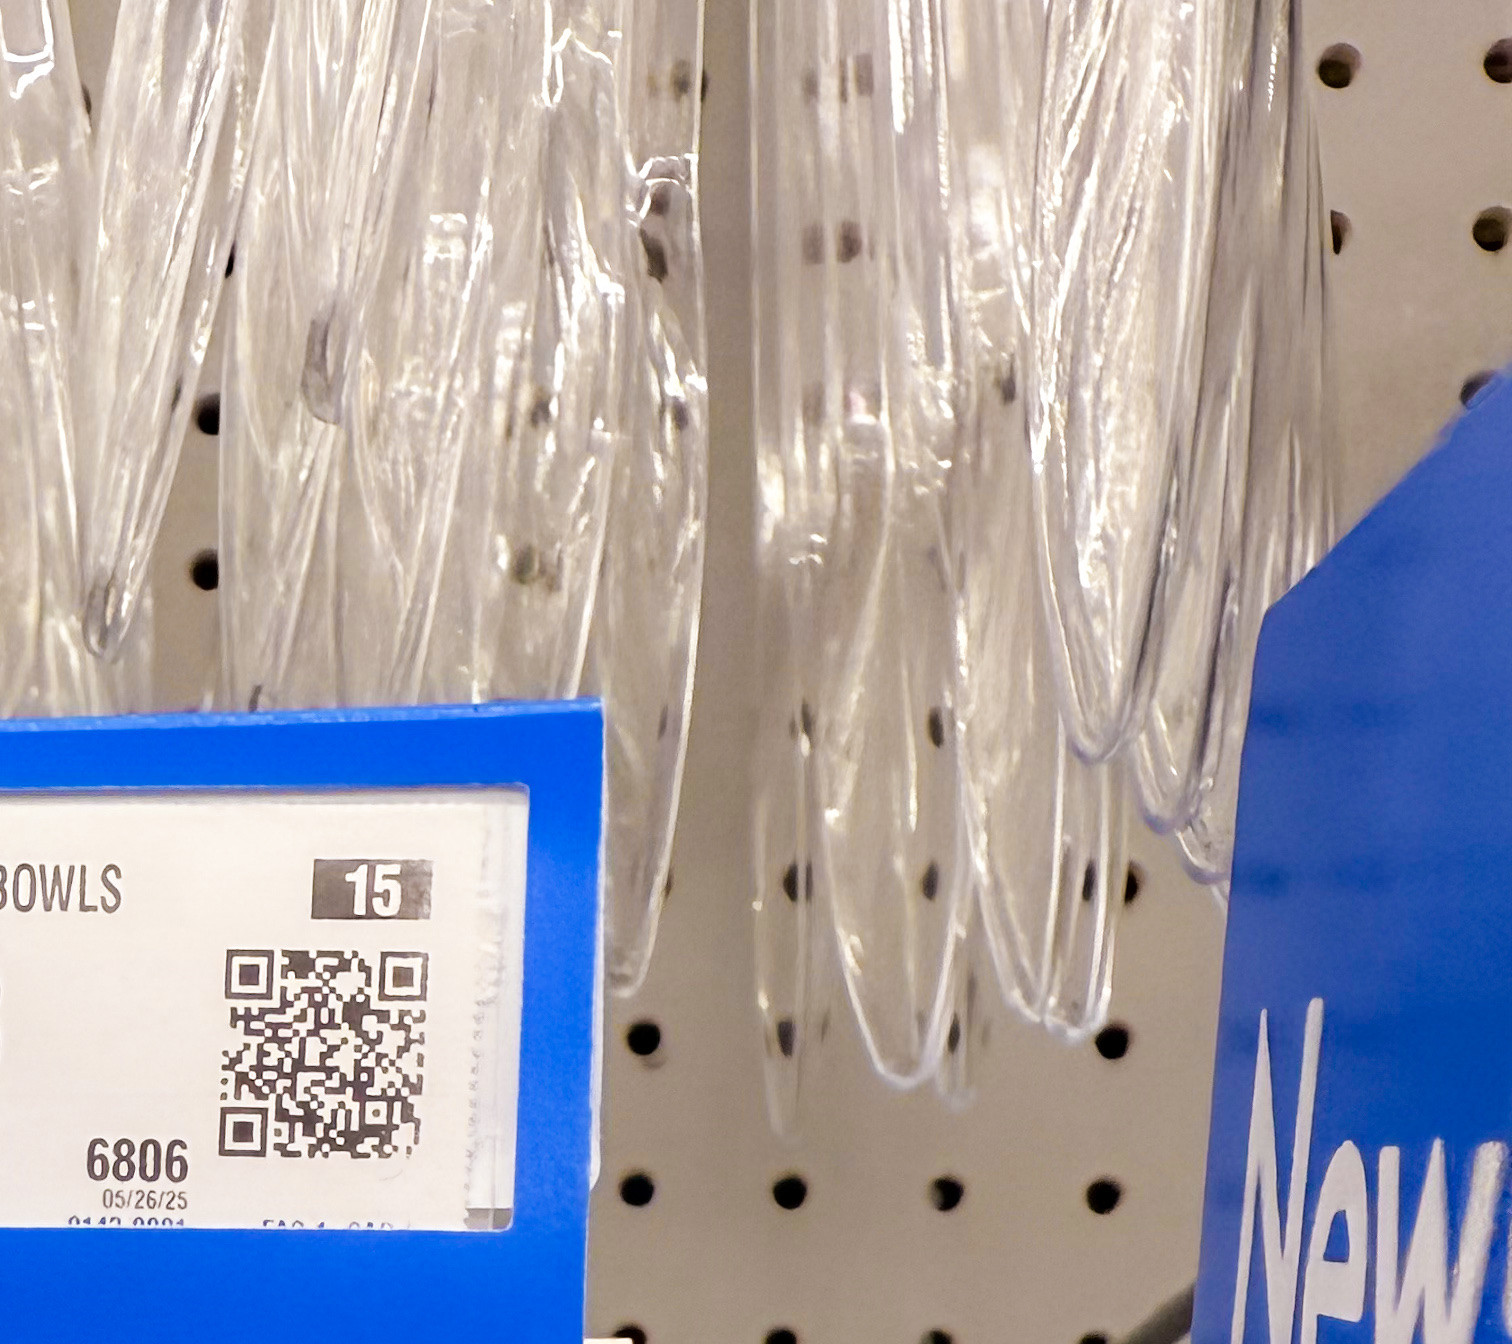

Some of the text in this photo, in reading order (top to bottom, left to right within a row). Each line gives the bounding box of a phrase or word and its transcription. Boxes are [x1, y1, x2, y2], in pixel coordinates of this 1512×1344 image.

[344, 863, 403, 917] 15
[86, 1137, 188, 1183] 6806
[102, 1189, 188, 1211] 05/26/25
